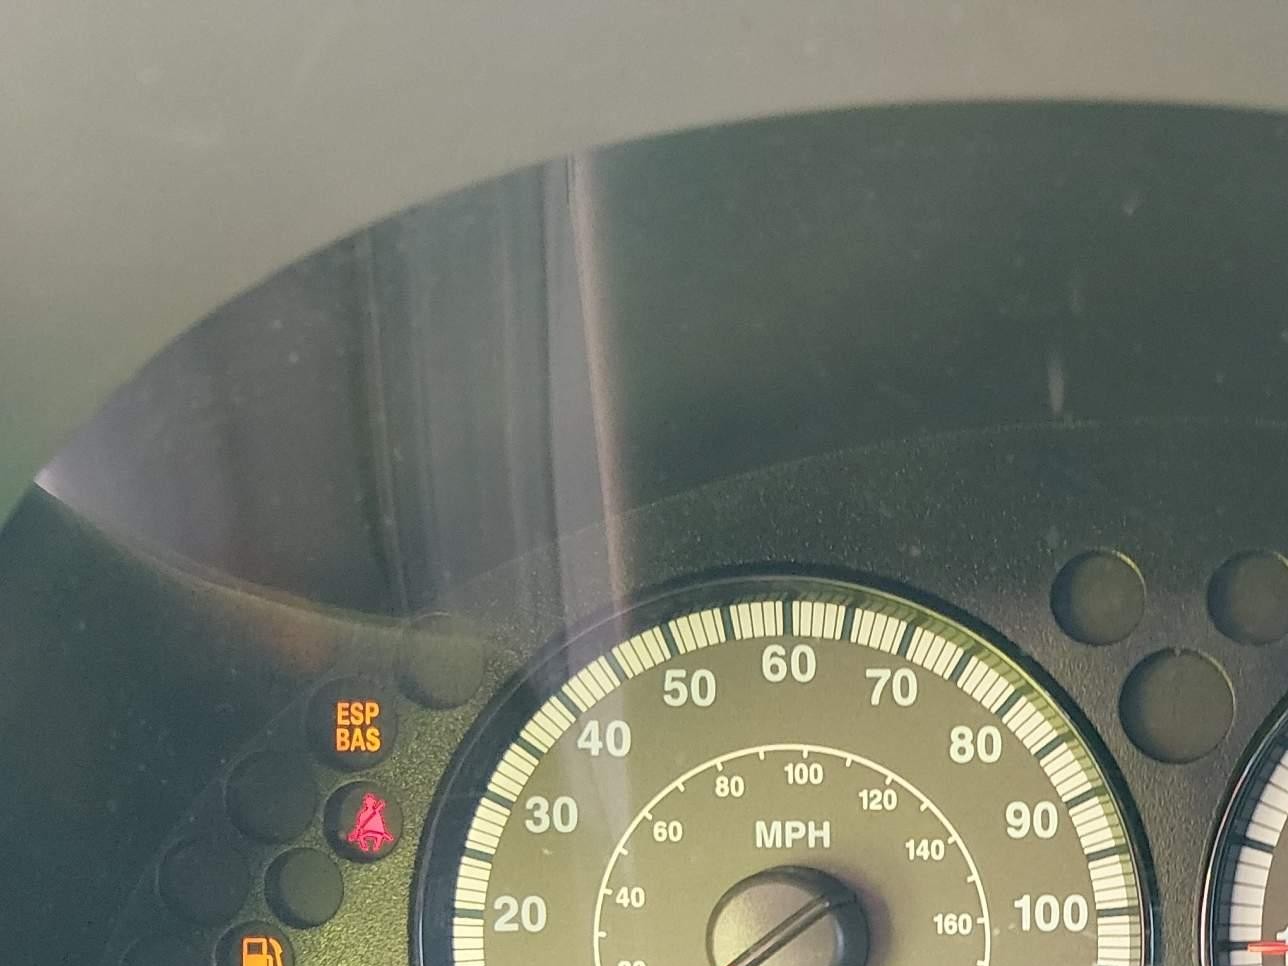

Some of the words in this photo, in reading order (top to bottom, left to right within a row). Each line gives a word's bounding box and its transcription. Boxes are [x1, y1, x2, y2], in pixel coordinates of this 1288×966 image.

[762, 644, 816, 683] 60
[663, 669, 716, 707] 50
[865, 668, 918, 706] 70
[336, 701, 380, 726] ESP
[336, 727, 381, 752] BAS
[577, 719, 631, 757] 40
[949, 725, 1002, 764] 80
[715, 775, 745, 797] 80
[784, 762, 824, 785] 100
[858, 788, 898, 811] 120
[525, 796, 578, 833] 30
[1005, 801, 1058, 839] 90
[652, 819, 683, 843] 60
[755, 820, 831, 849] MPH
[905, 839, 945, 861] 140
[615, 886, 645, 908] 40
[493, 895, 547, 932] 20
[933, 913, 972, 935] 160
[1014, 894, 1088, 932] 100
